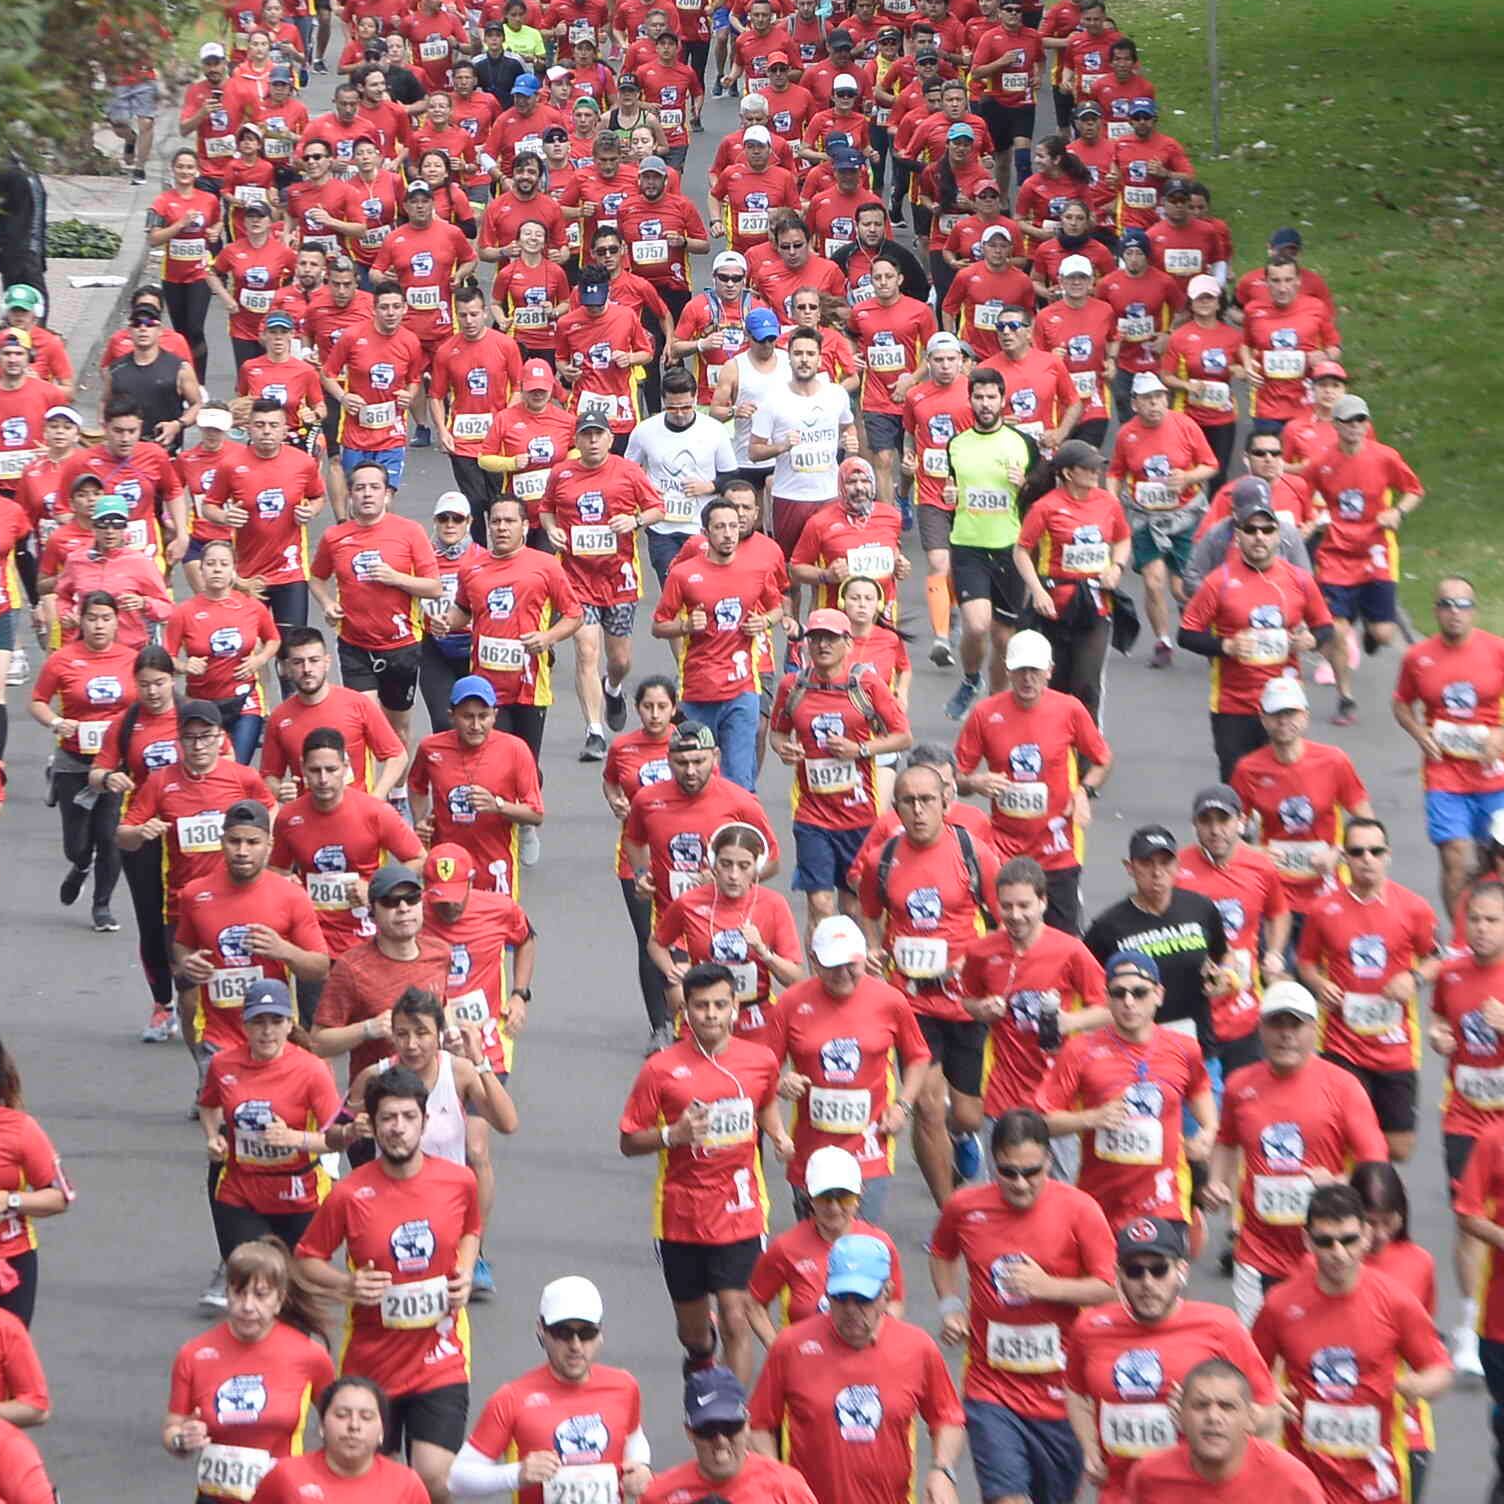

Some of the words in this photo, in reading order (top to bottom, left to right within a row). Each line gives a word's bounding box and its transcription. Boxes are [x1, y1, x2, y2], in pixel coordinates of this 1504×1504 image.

[636, 245, 664, 259] 3757
[410, 291, 437, 305] 1401
[516, 311, 545, 324] 2381
[869, 351, 902, 366] 2834
[366, 409, 390, 425] 361
[456, 419, 490, 435] 4924
[795, 449, 831, 467] 4015
[968, 491, 1007, 509] 2394
[576, 533, 614, 550] 4375
[480, 643, 521, 664] 4626
[809, 764, 852, 787] 3927
[184, 824, 220, 845] 130
[900, 948, 936, 967] 1177
[213, 976, 257, 999] 163
[386, 1292, 446, 1318] 2031
